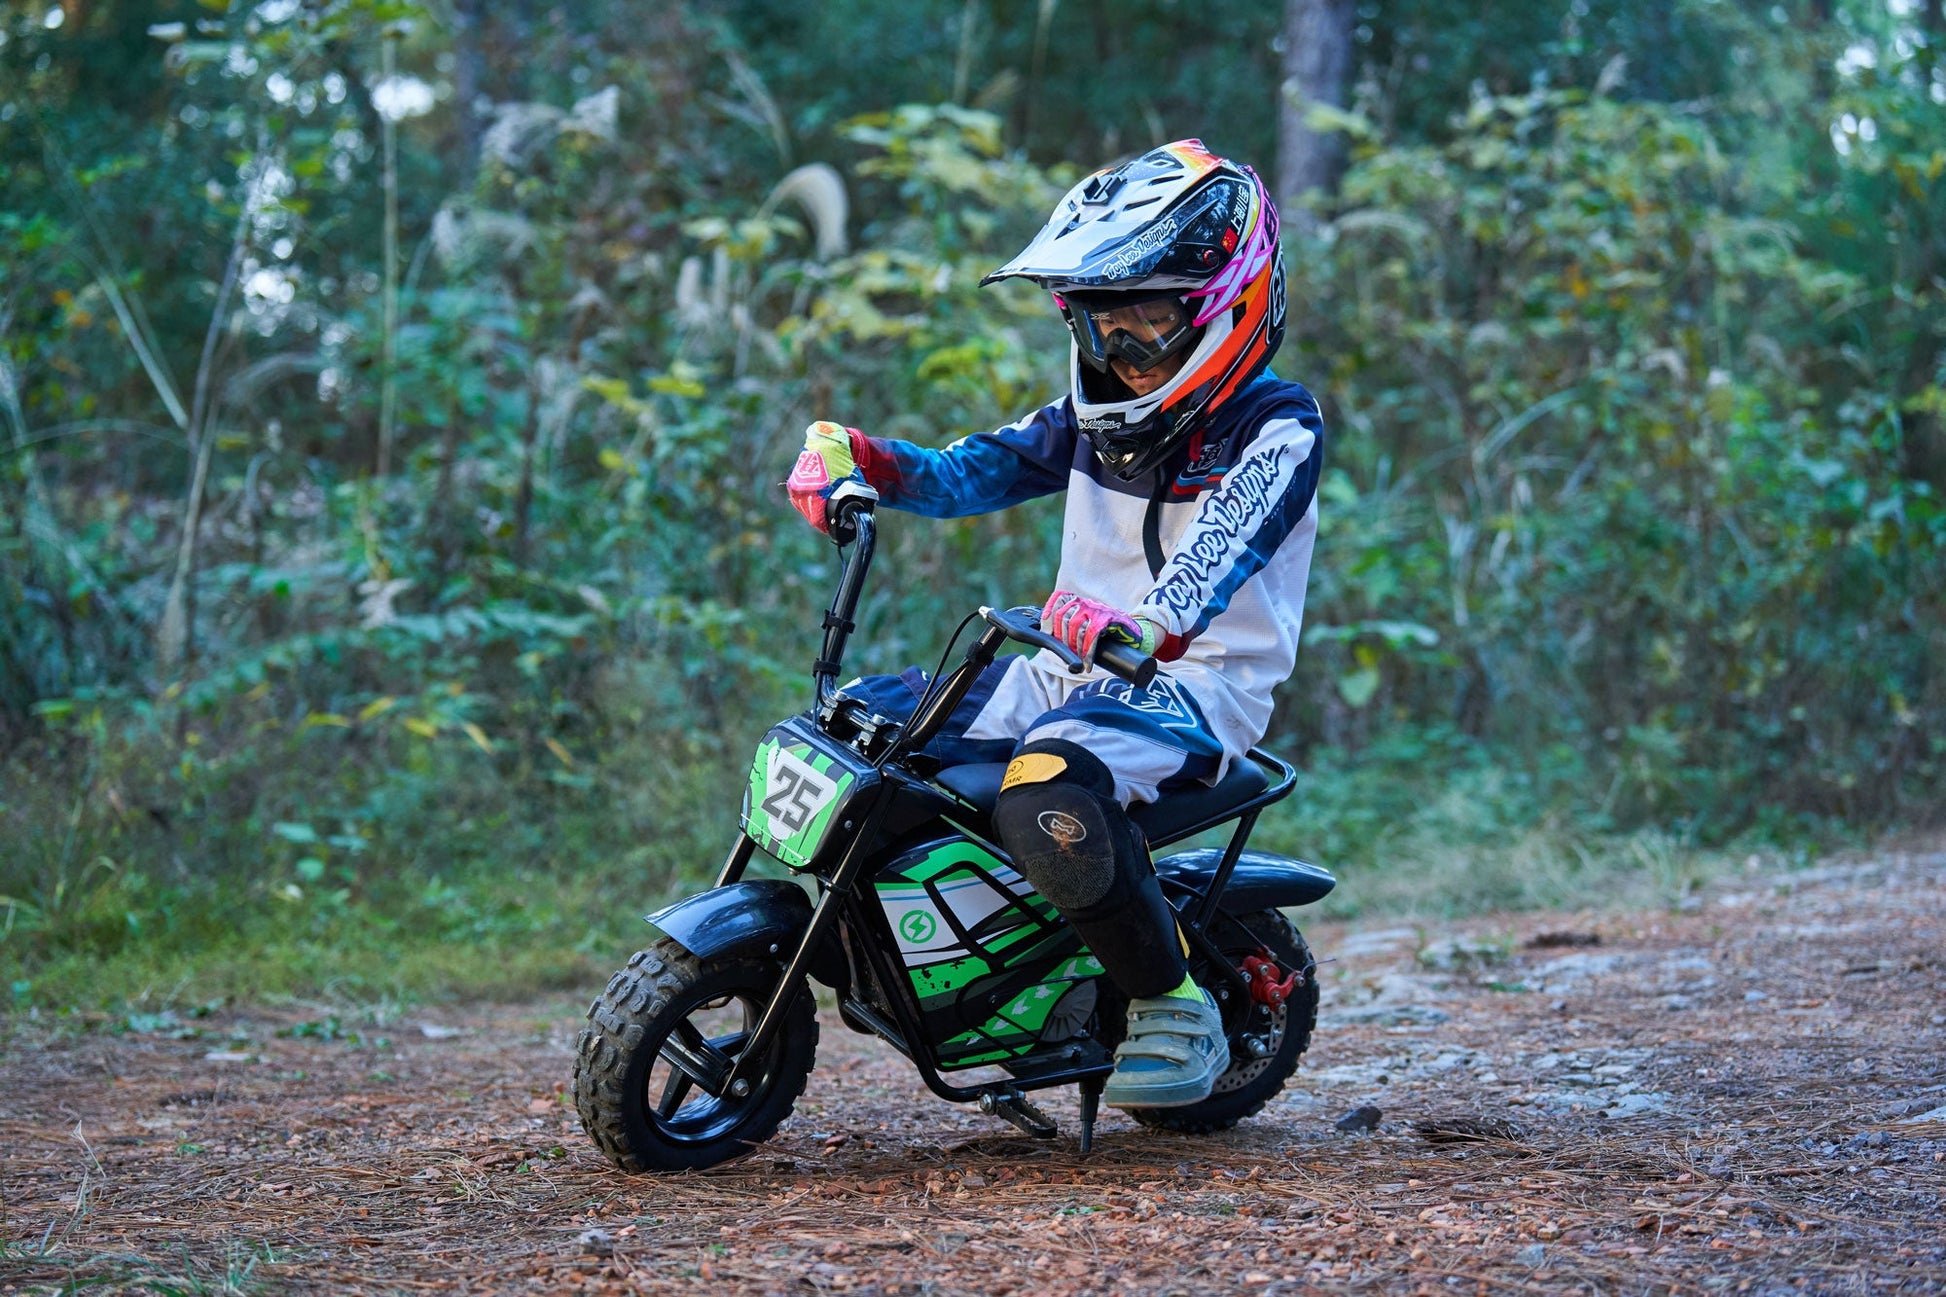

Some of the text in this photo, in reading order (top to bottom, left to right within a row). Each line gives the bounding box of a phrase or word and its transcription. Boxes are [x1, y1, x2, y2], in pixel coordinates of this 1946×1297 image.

[1102, 218, 1177, 280] Troy Lee Designs
[1197, 443, 1288, 538] Designs
[1173, 528, 1230, 581] Lee
[760, 765, 824, 832] 25
